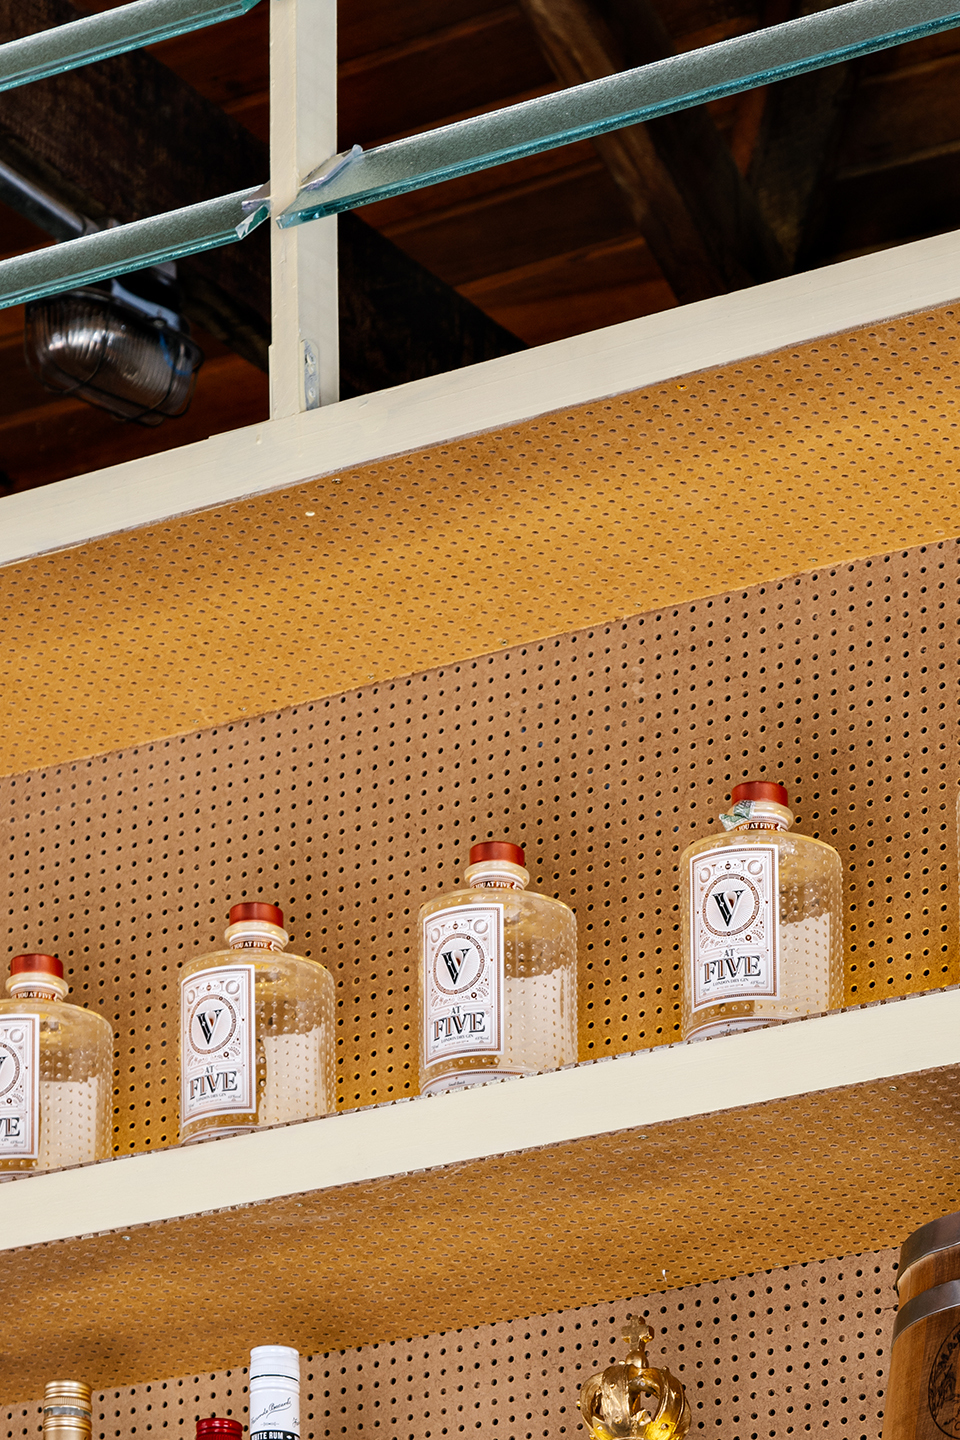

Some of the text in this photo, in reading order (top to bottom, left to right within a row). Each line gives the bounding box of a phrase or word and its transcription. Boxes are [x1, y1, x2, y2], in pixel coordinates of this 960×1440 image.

[712, 889, 746, 927] V
[441, 948, 472, 985] V
[723, 948, 734, 957] AT
[703, 955, 761, 985] FIVE
[451, 1005, 461, 1014] AT
[196, 1008, 224, 1045] V
[433, 1012, 485, 1041] FIVE
[204, 1065, 214, 1074] AT
[189, 1070, 237, 1100] FIVE
[269, 1431, 284, 1440] RUM
